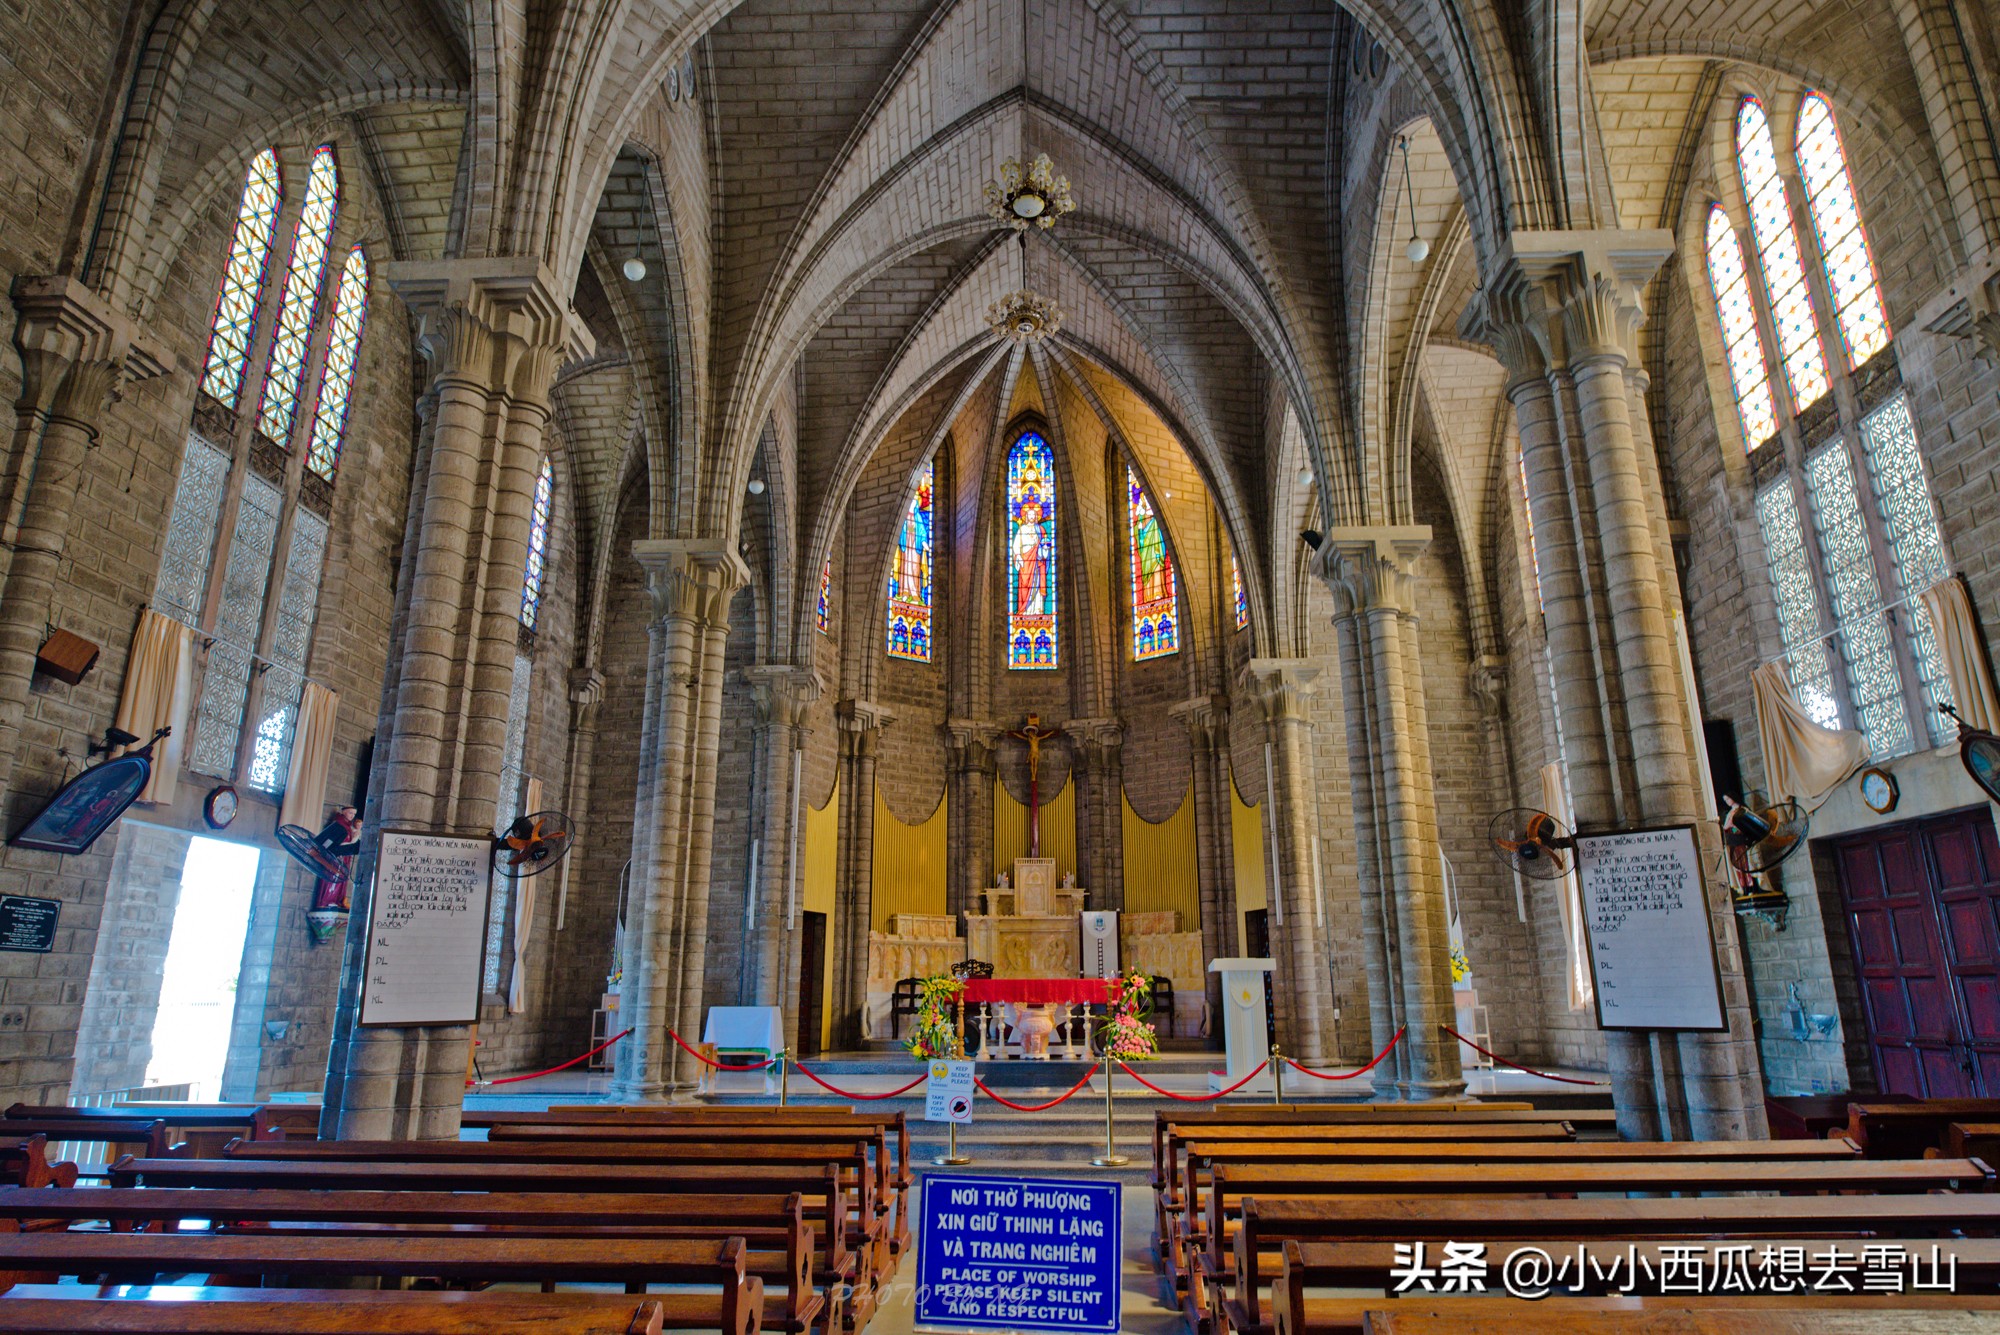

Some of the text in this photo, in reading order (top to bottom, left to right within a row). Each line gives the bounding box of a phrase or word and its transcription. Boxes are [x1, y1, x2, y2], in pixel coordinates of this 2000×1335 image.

[410, 838, 422, 846] XIX
[951, 1187, 1091, 1213] NƠI THỜ PHƯỢNG
[937, 1212, 1104, 1240] XIN GIỮ THINH LẶNG
[942, 1236, 1096, 1264] VÀ TRANG NGHIÊM
[942, 1267, 1096, 1287] PLACE OF WORSHIP
[934, 1283, 1103, 1304] PLEASE KEEP SILENT
[948, 1302, 1088, 1321] AND RESPECTFUL
